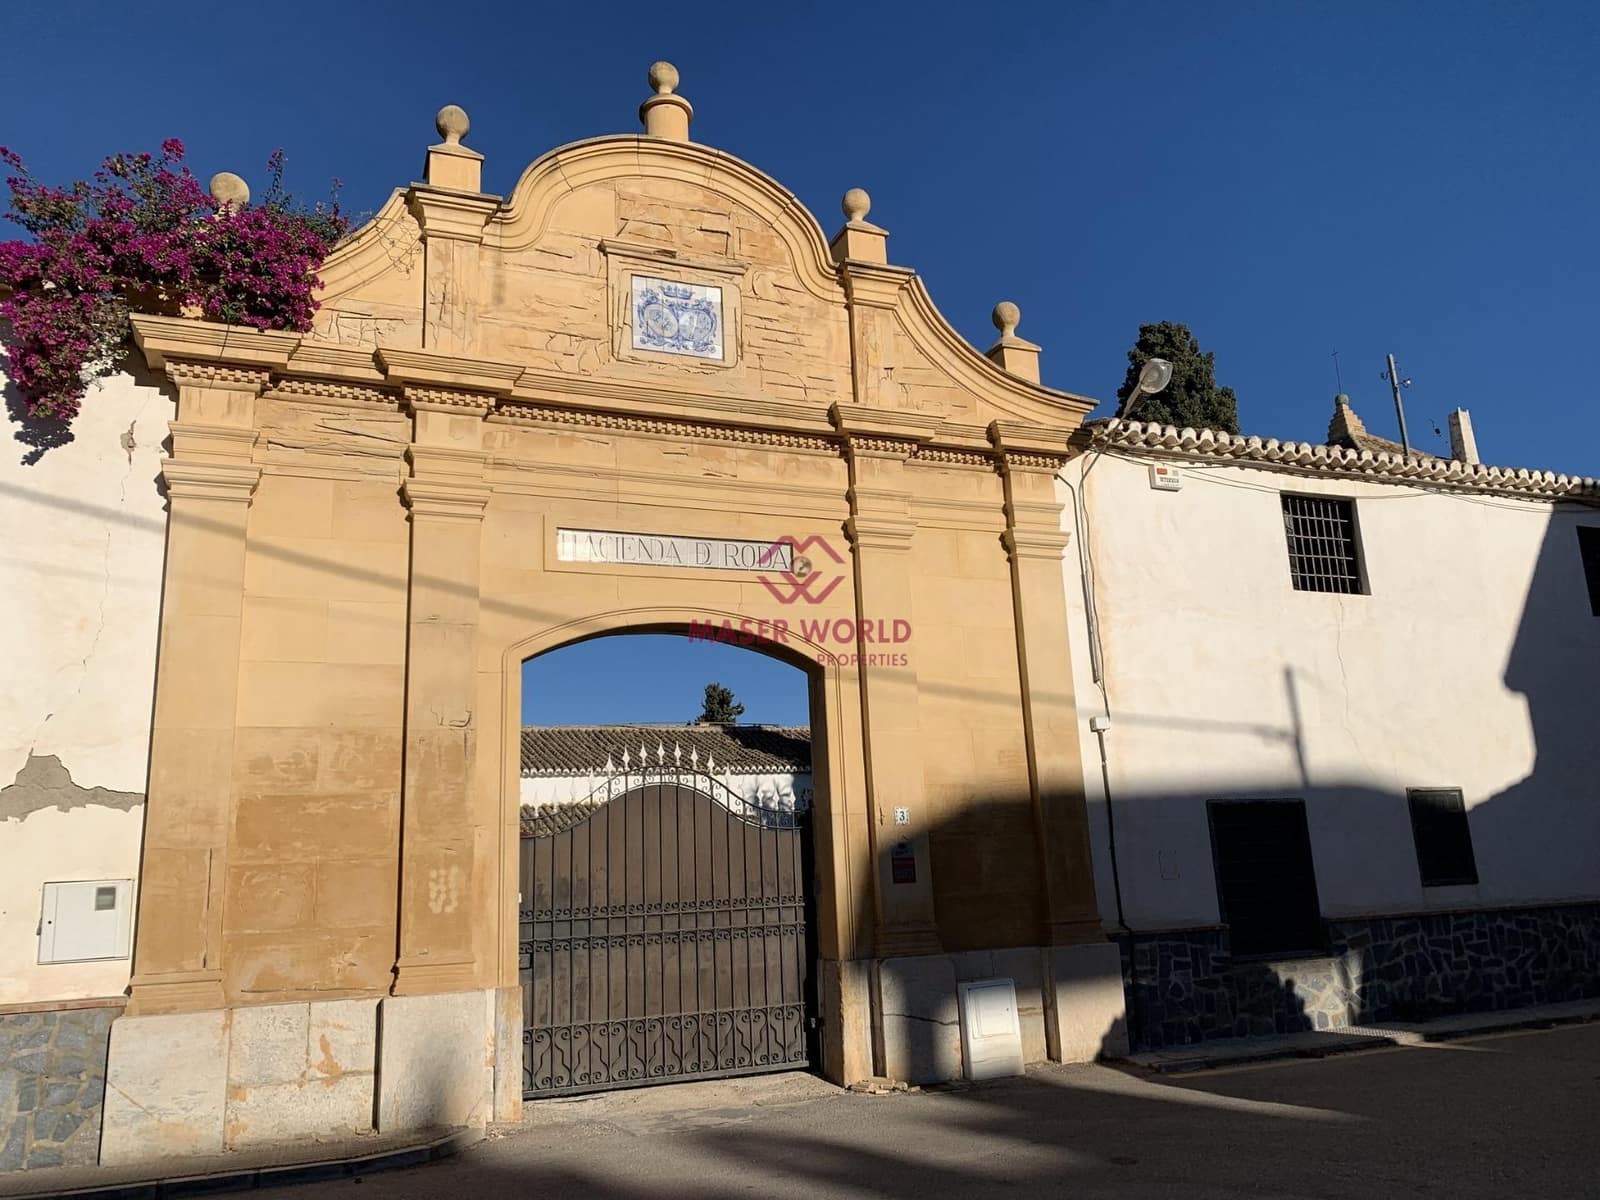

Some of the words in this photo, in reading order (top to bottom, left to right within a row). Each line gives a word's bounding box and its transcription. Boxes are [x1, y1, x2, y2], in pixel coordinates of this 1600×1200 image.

[560, 533, 682, 564] HACIENDA
[724, 543, 789, 569] RODA
[899, 810, 905, 822] 3
